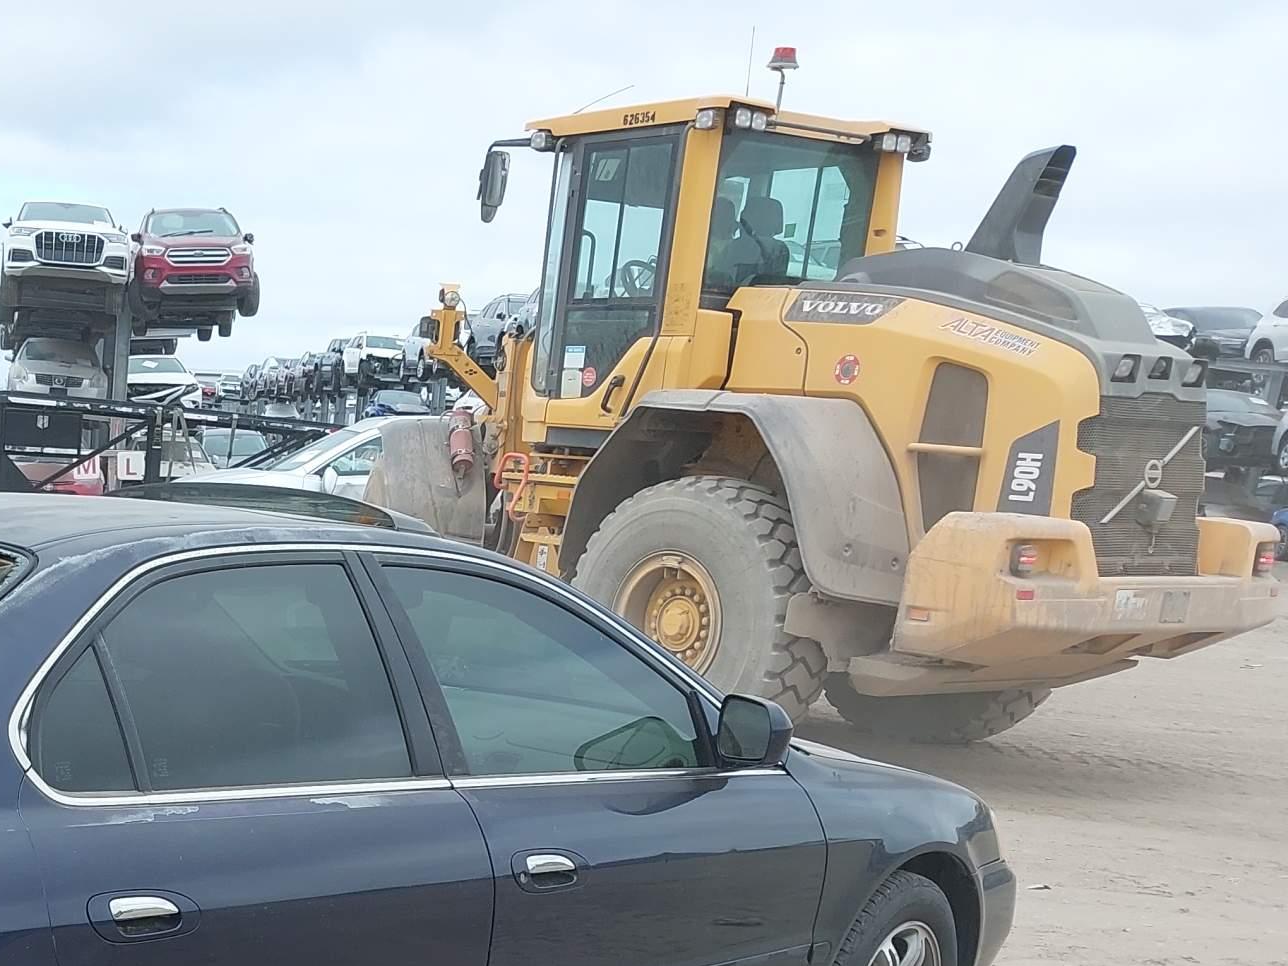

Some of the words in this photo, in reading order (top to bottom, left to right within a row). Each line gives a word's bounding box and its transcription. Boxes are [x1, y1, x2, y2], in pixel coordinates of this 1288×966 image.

[623, 111, 656, 125] 626354
[802, 299, 884, 316] VOLVO
[941, 318, 996, 342] ALTA
[994, 329, 1041, 350] EQUIPMENT
[988, 335, 1035, 357] COMPANY
[77, 458, 97, 476] M
[126, 458, 137, 475] L
[1008, 452, 1043, 502] L90H
